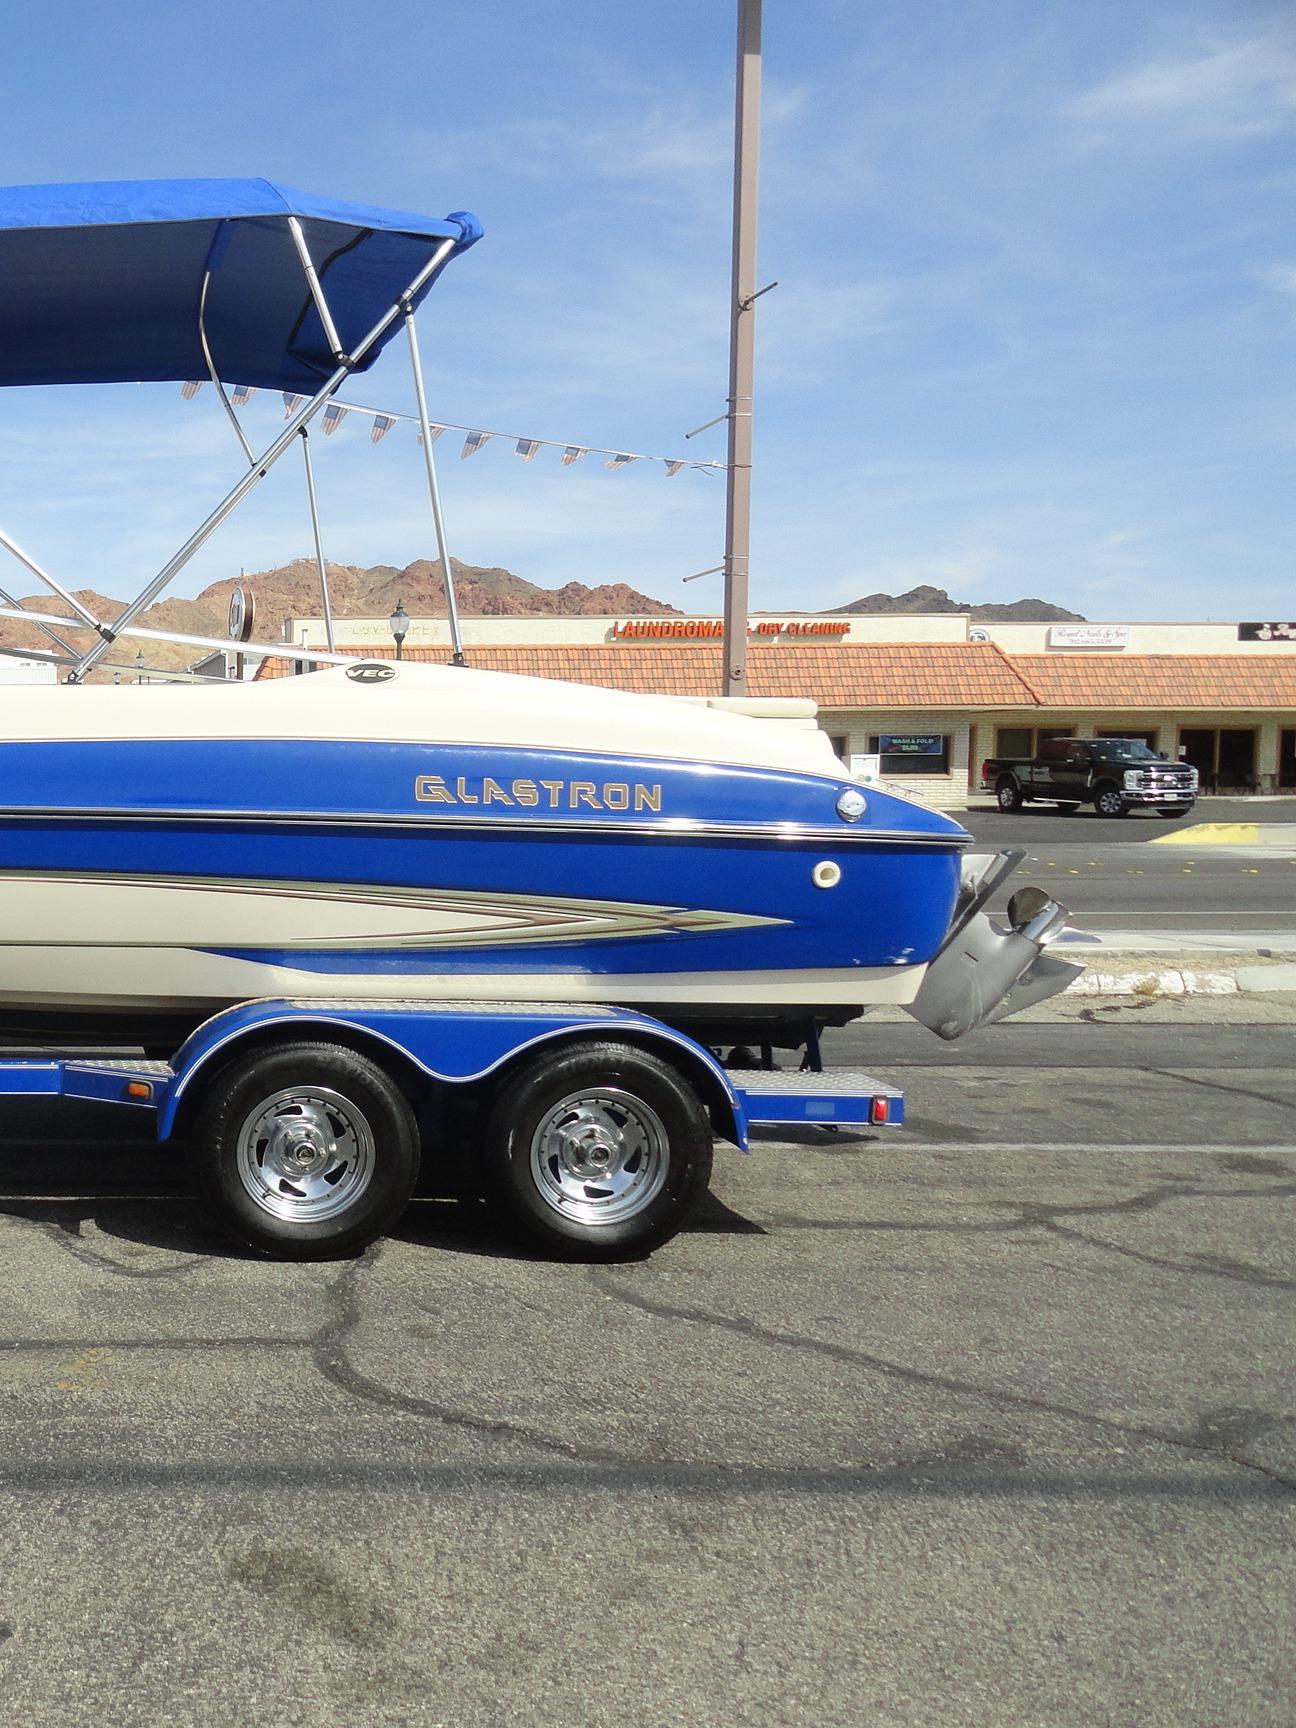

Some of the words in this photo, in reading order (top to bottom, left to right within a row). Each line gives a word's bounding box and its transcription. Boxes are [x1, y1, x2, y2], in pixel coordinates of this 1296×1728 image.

[613, 621, 724, 638] LAUNDROMA
[787, 622, 851, 635] CLEANING
[346, 669, 395, 678] VEC
[415, 775, 661, 811] GLASTRON
